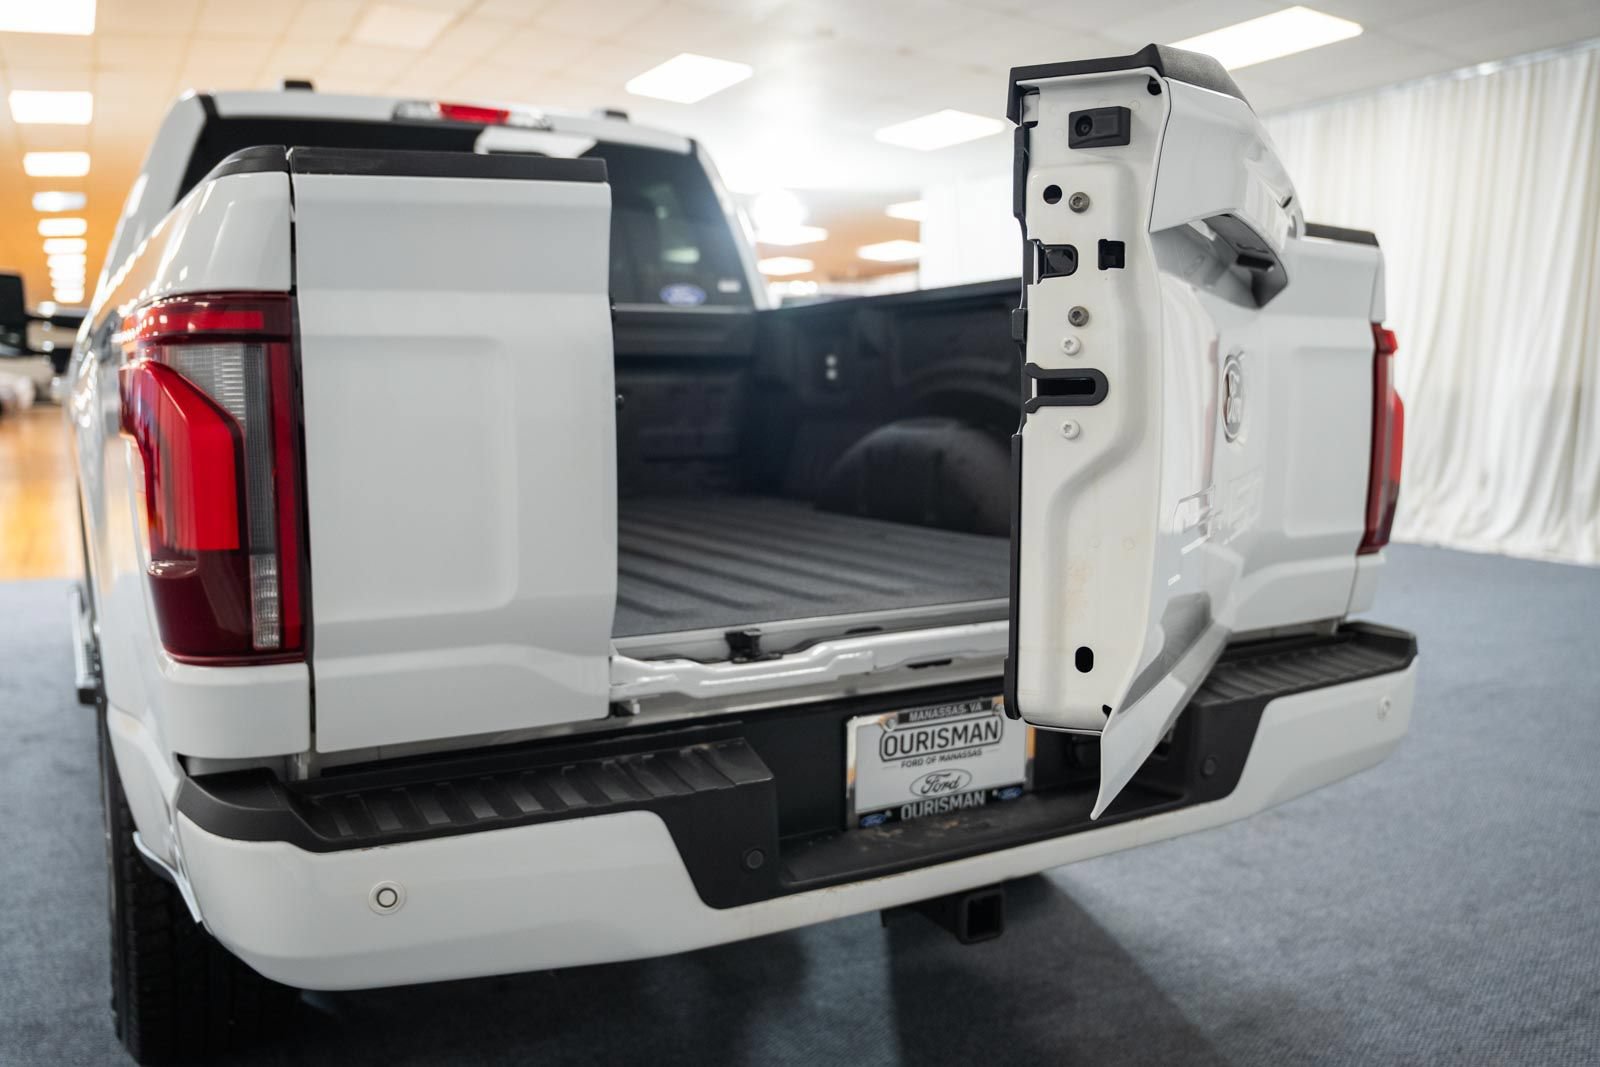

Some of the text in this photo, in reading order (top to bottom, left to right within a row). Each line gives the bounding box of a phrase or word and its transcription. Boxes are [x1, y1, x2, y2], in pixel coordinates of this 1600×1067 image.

[970, 702, 982, 712] VA
[884, 720, 998, 757] OURISMAN
[901, 748, 983, 768] FORD OF MANASSAS
[920, 772, 961, 795] Ford
[900, 790, 985, 820] OURISMAN
